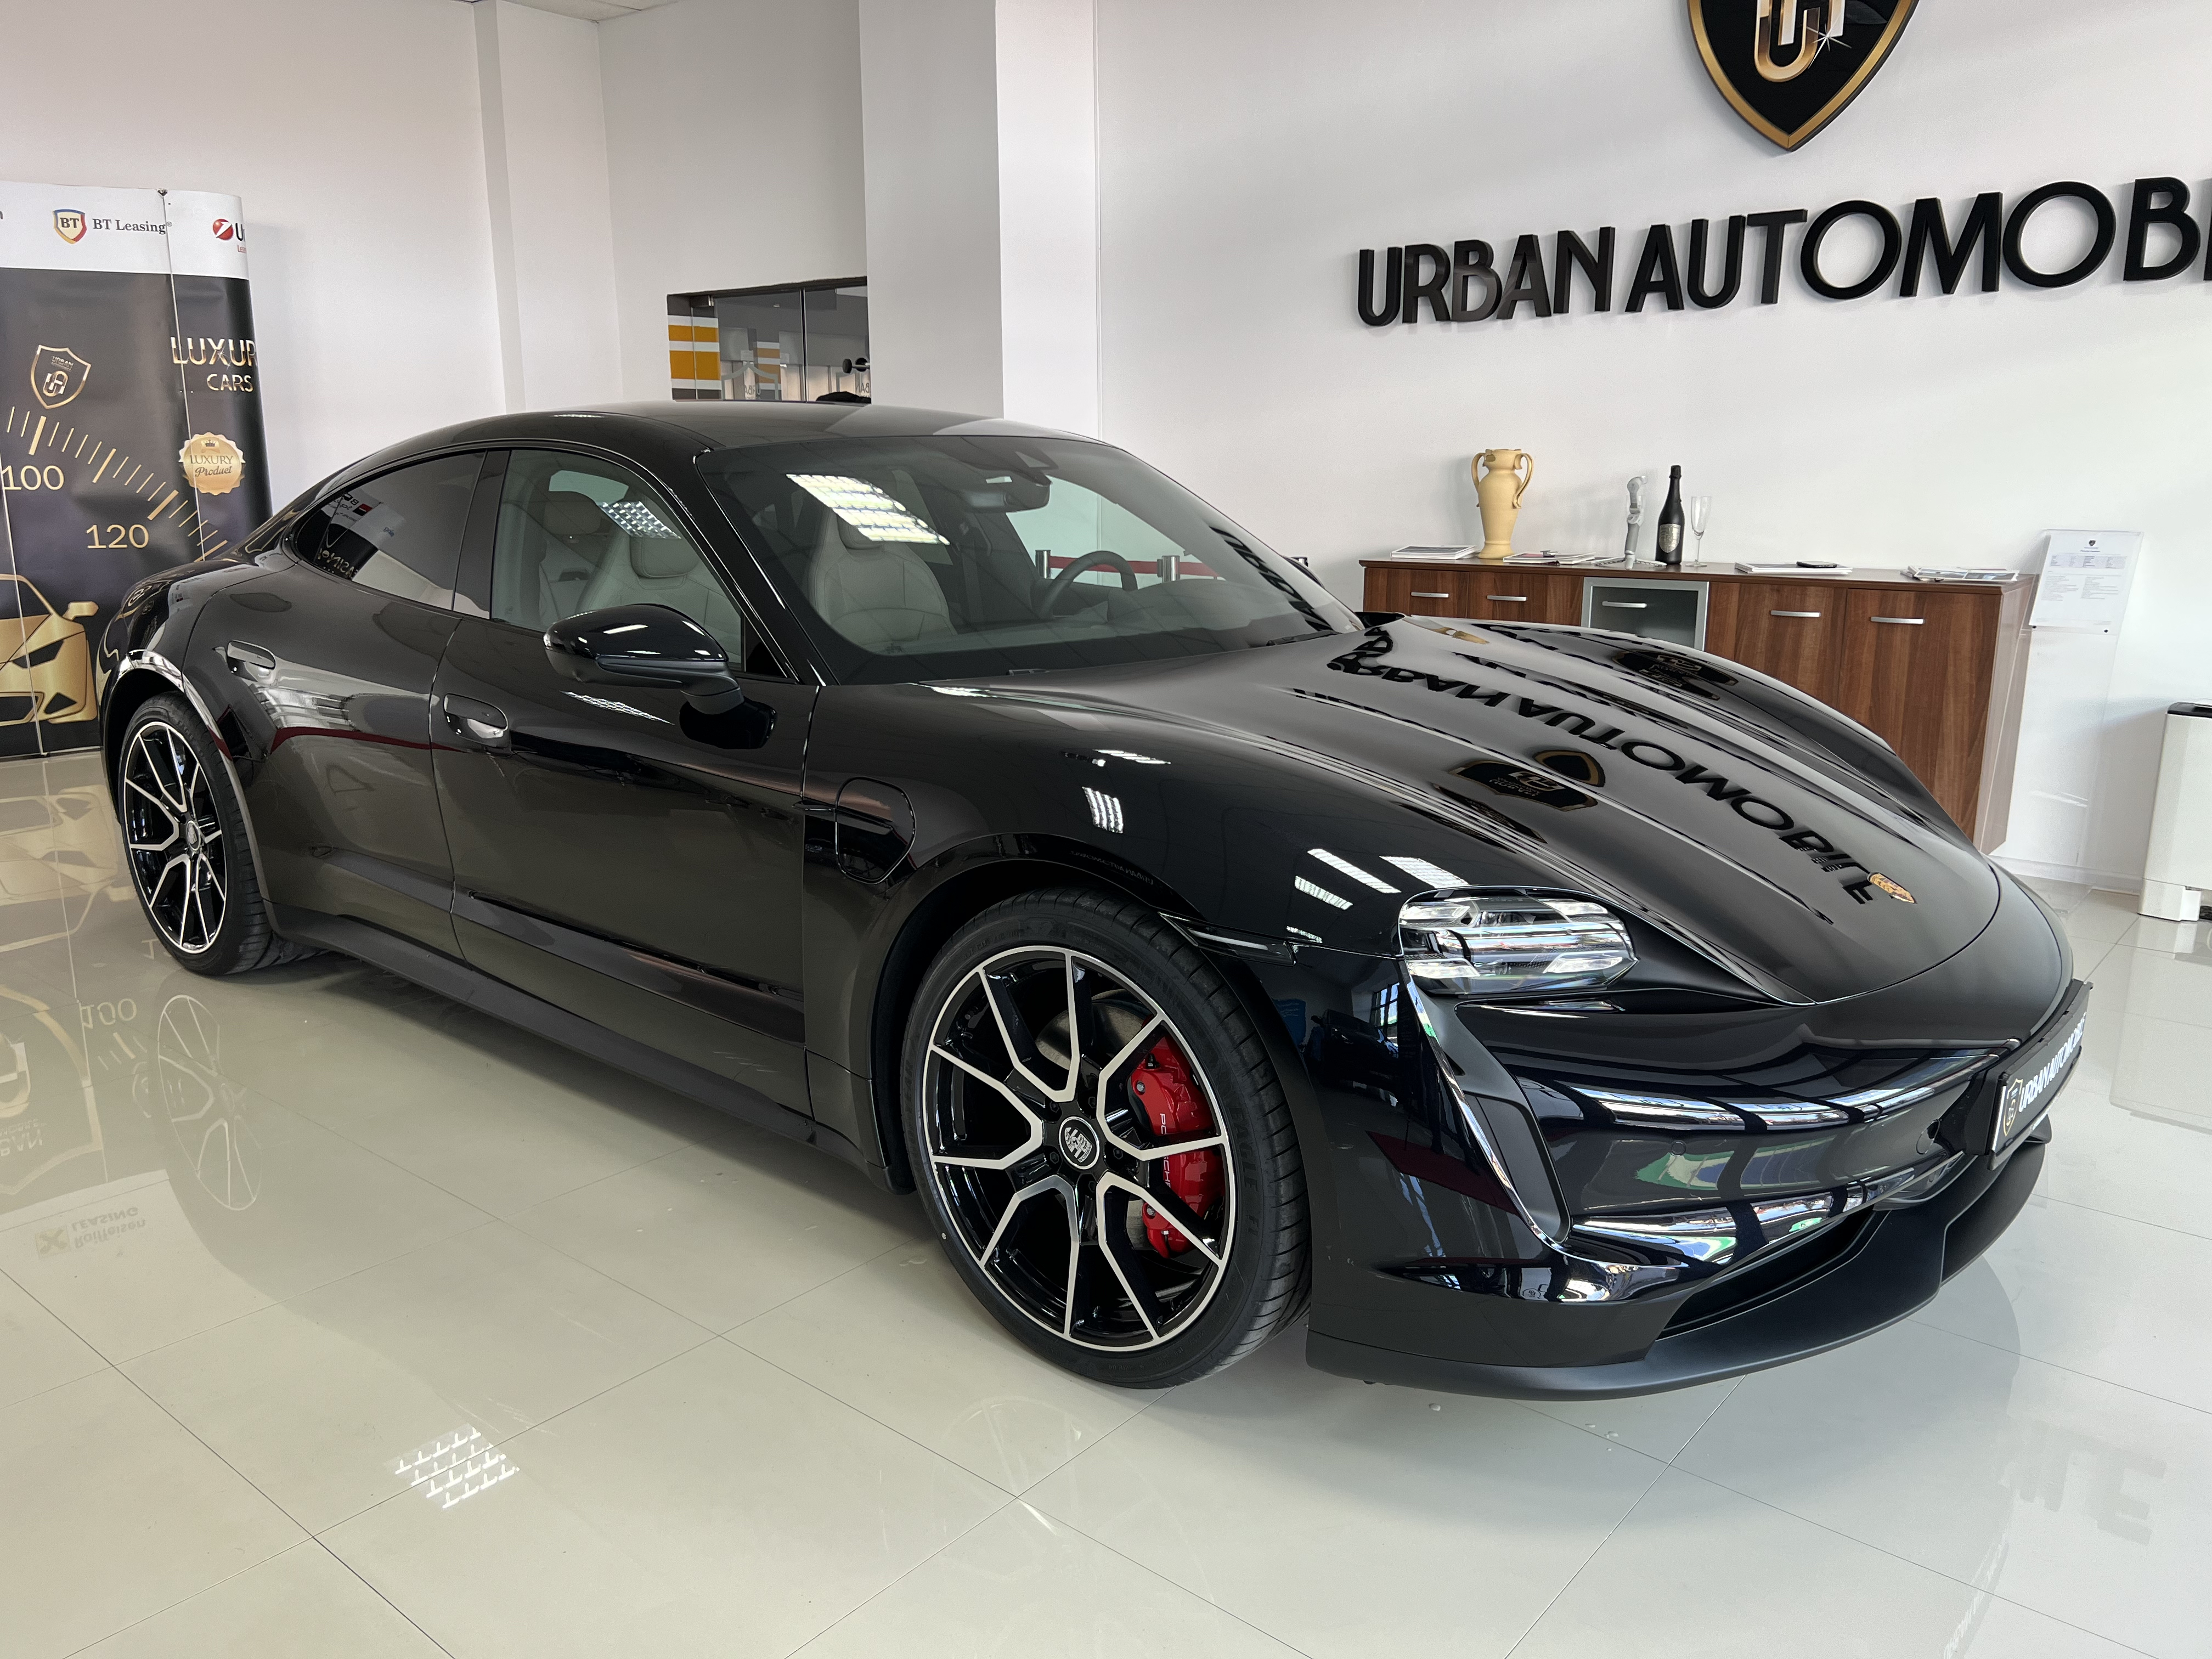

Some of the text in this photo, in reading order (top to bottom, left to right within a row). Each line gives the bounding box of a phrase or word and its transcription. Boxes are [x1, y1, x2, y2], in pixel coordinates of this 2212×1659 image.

[60, 217, 79, 228] BT
[93, 218, 111, 230] BT
[1358, 226, 1616, 326] URBAN
[207, 374, 253, 392] CARS
[190, 455, 234, 464] LUXURY
[2, 465, 64, 490] 100
[195, 465, 233, 477] Product
[86, 524, 149, 549] 120
